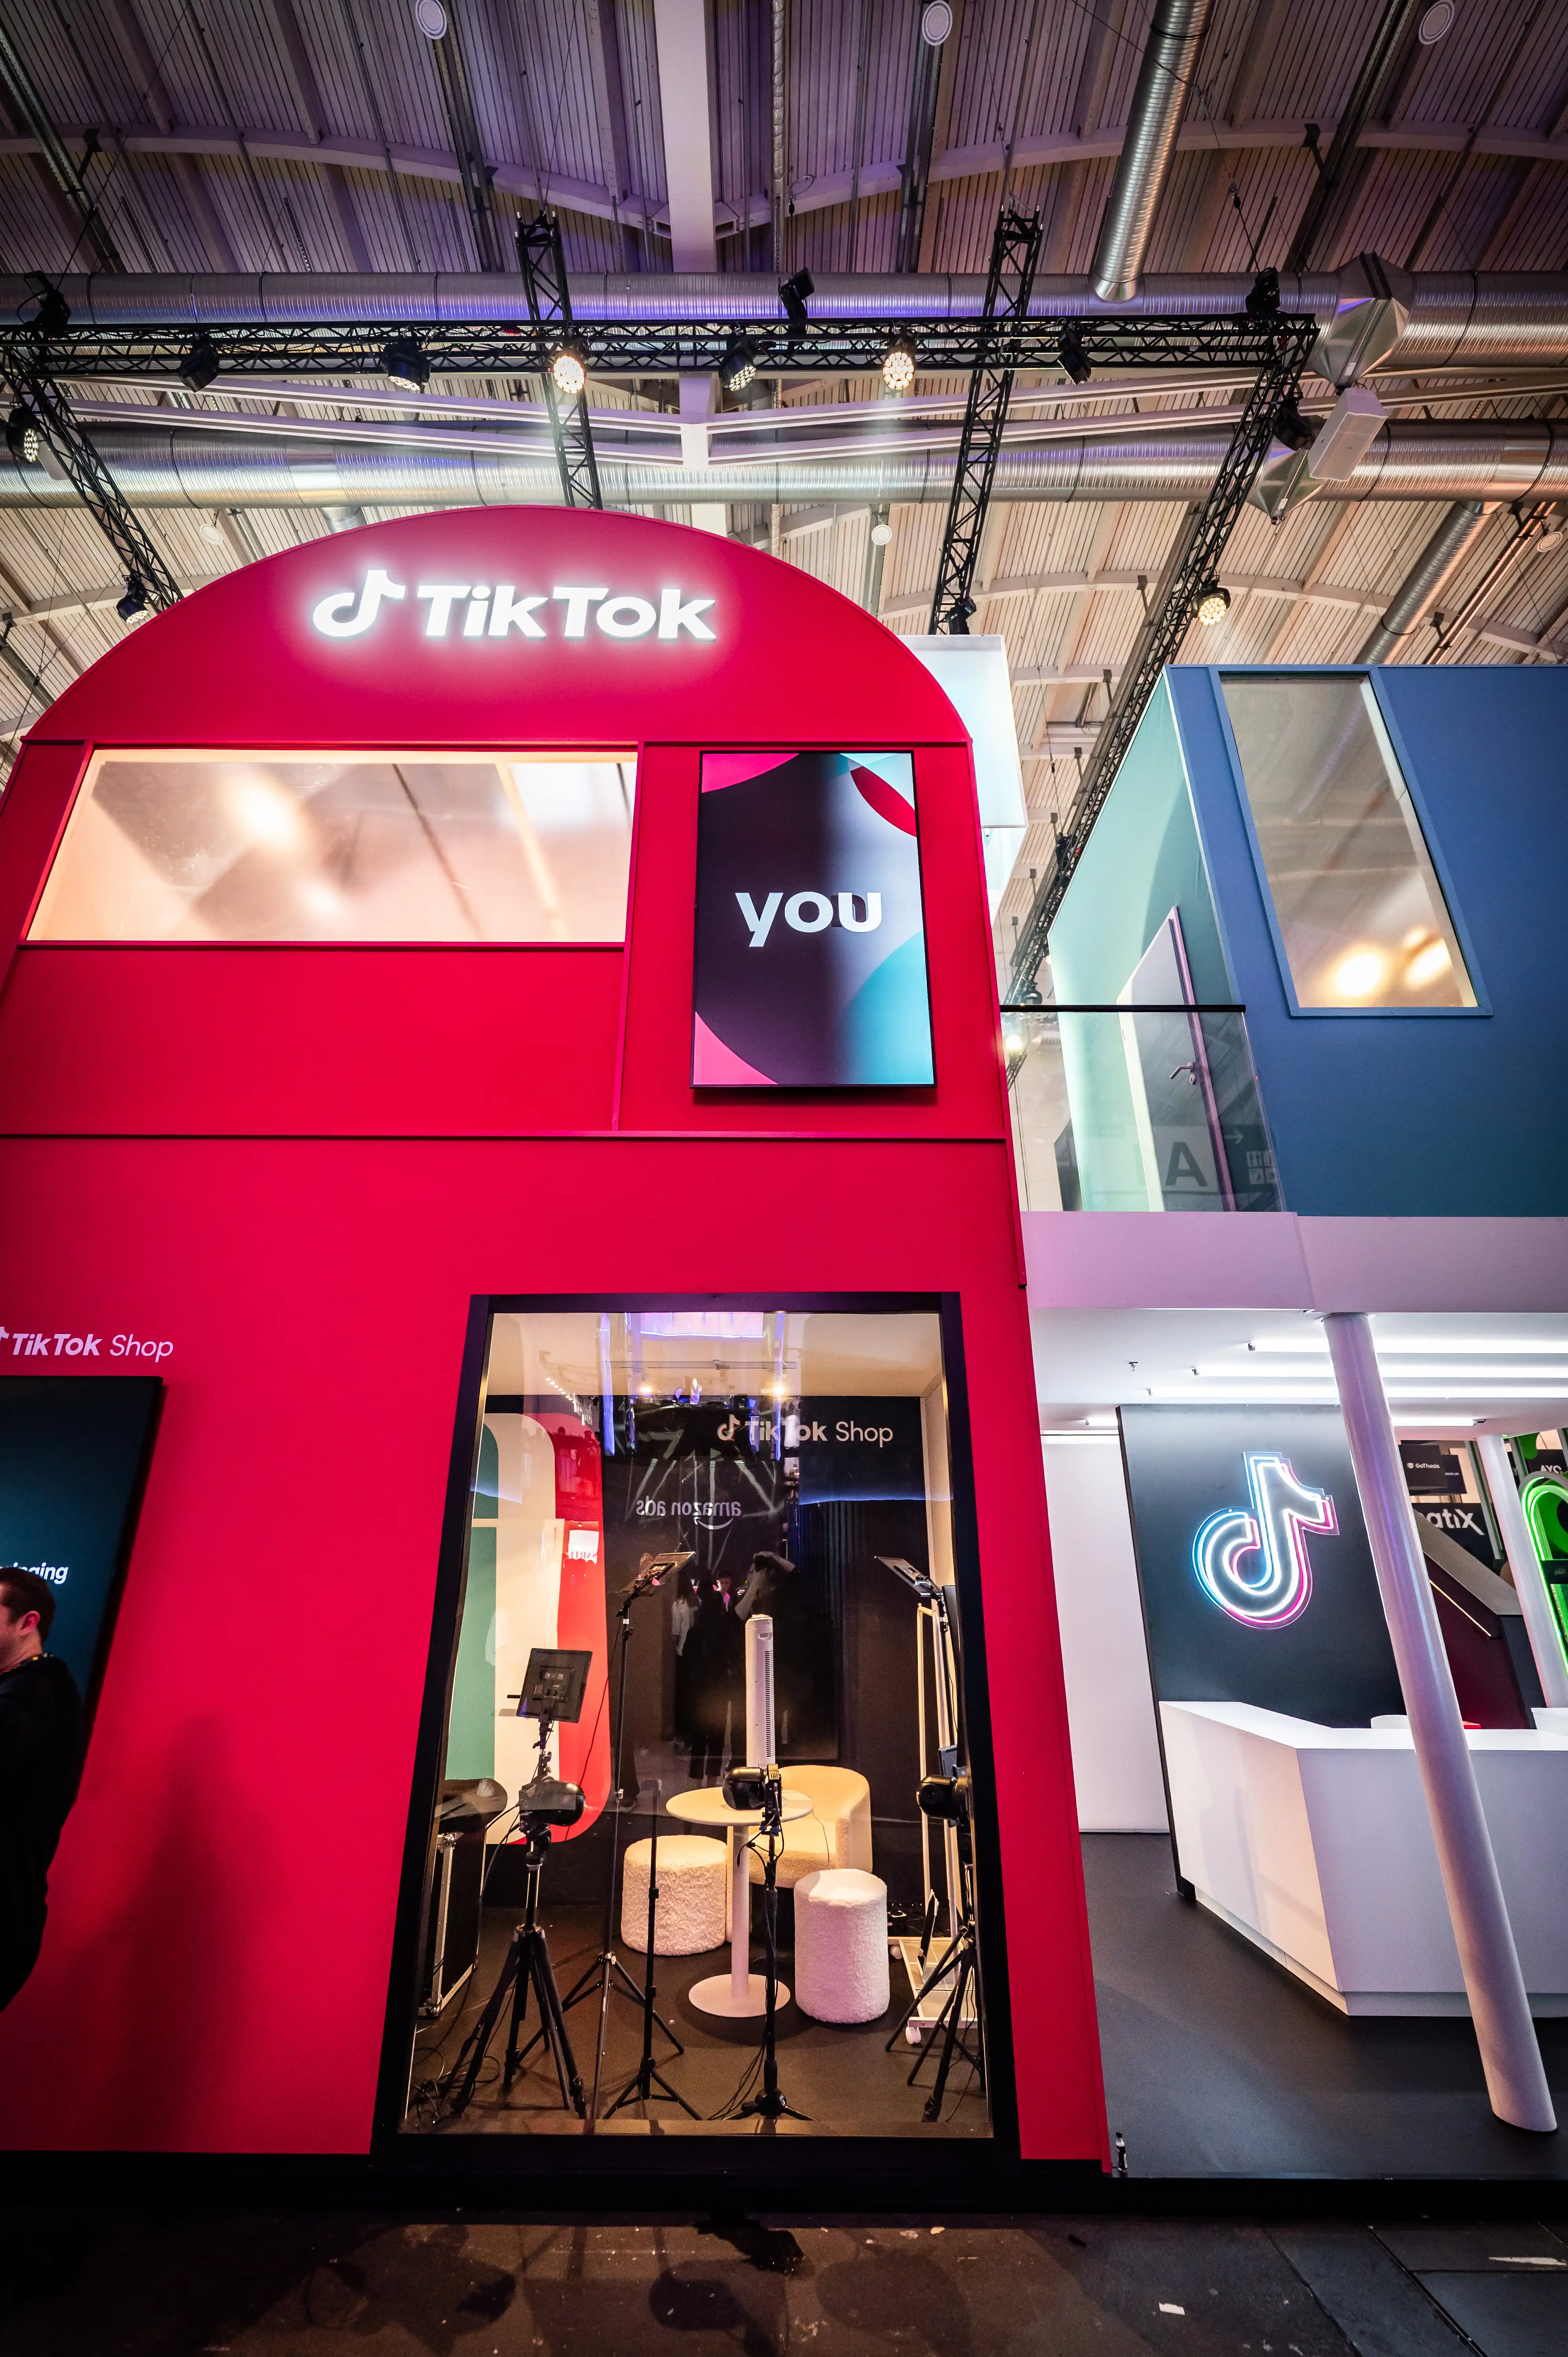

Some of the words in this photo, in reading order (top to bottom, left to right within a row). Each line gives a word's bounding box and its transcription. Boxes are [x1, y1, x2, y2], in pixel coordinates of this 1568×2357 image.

[417, 585, 716, 641] TikTok
[735, 891, 882, 947] you
[12, 1333, 103, 1356] TikTok
[110, 1334, 173, 1363] Shop
[836, 1420, 893, 1448] Shop
